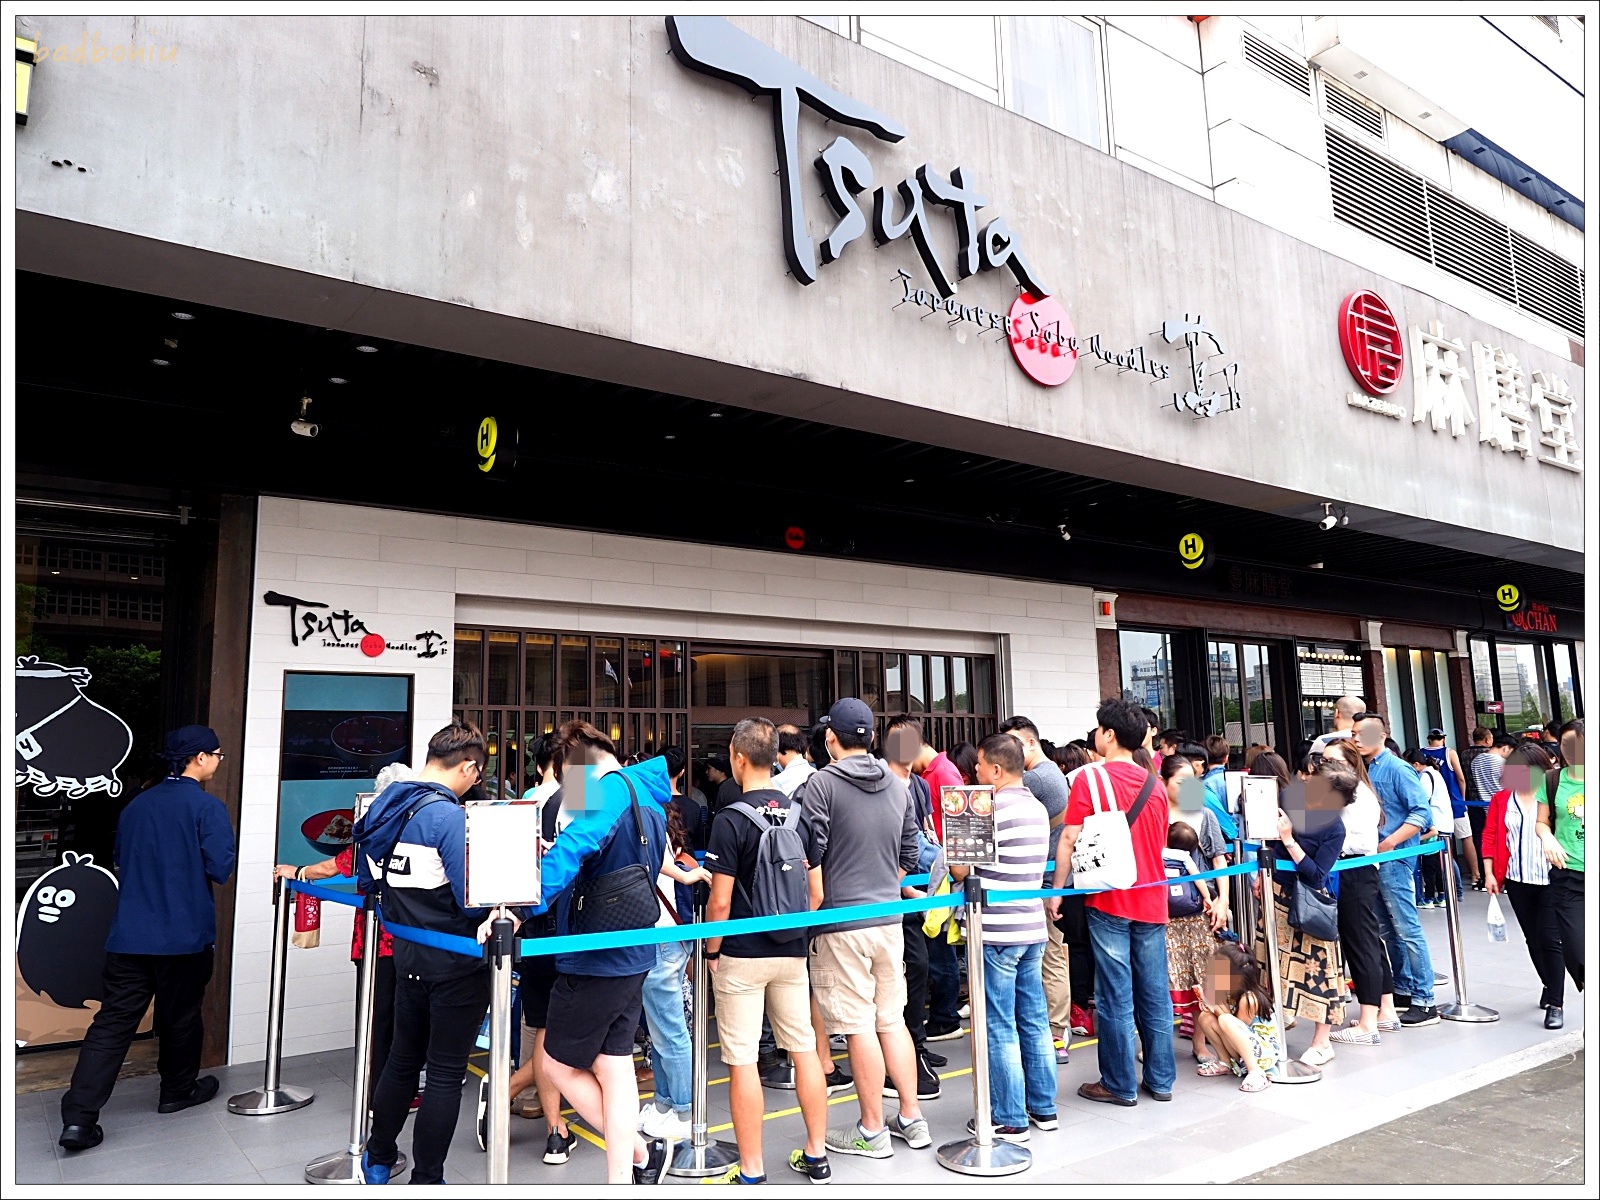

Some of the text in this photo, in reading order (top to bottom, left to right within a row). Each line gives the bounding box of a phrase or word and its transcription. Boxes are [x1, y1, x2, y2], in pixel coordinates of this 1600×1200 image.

[665, 16, 1052, 298] Tsuta
[1089, 334, 1170, 380] Noodles
[1408, 320, 1584, 473] 麻膳堂
[263, 590, 375, 647] Tsuta
[1526, 611, 1558, 633] CHAN
